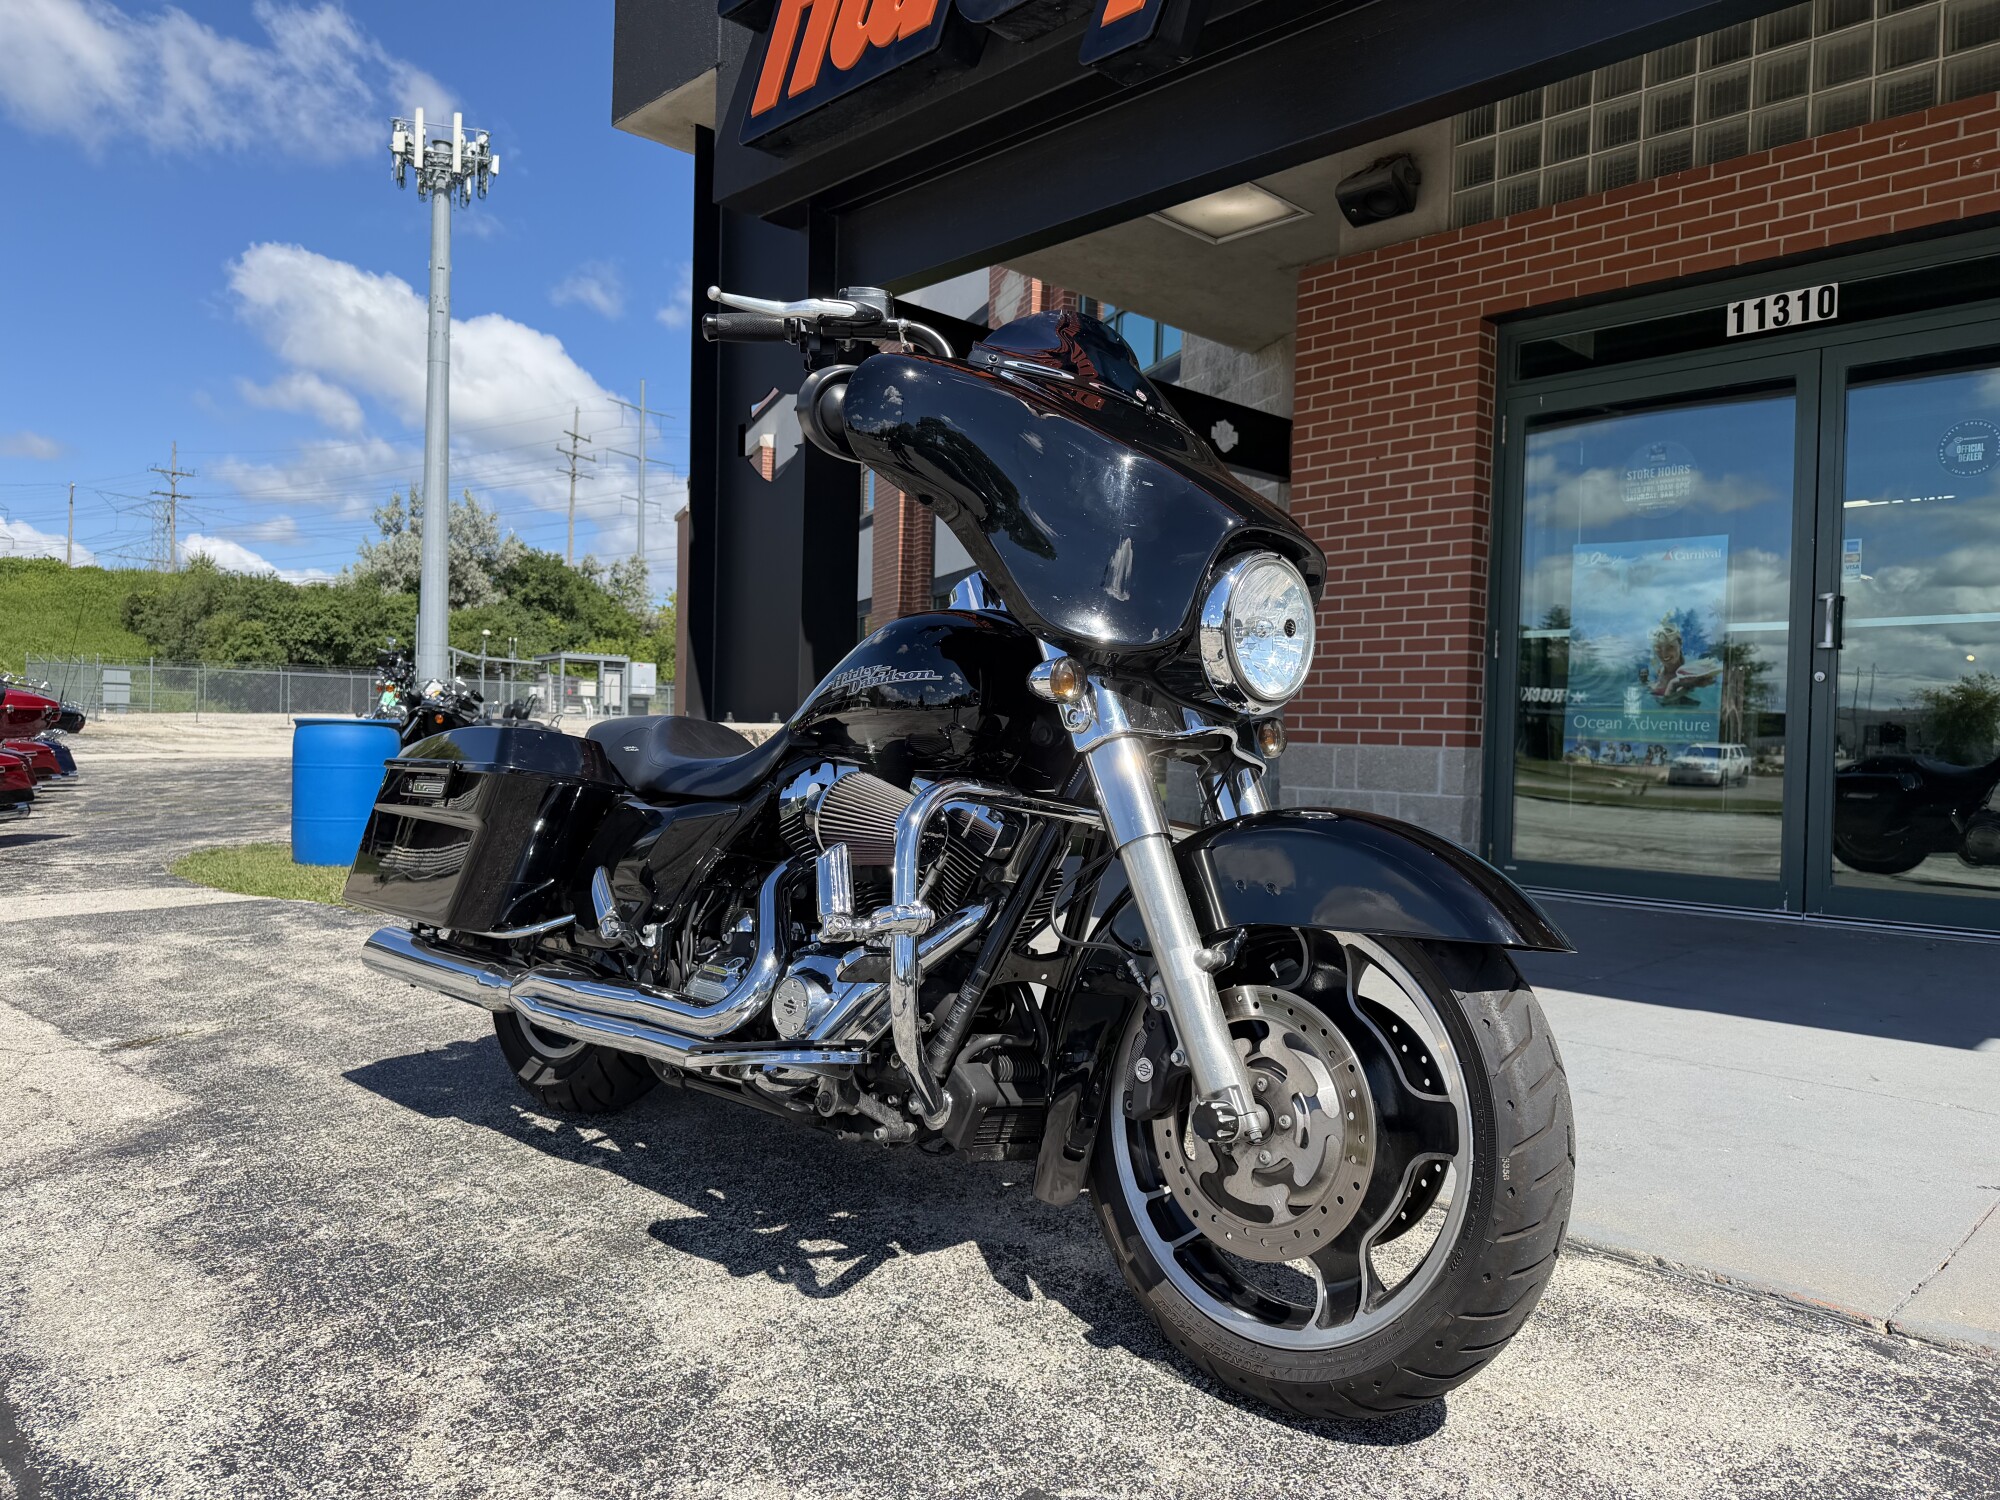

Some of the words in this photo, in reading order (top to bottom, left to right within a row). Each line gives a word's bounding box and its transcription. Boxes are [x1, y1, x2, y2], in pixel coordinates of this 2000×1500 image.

[1732, 285, 1836, 334] 11310
[1956, 443, 1985, 453] OFFICIAL
[1958, 452, 1983, 462] DEALER
[1626, 467, 1656, 481] STORE
[1657, 464, 1691, 477] HOURS
[1674, 548, 1722, 561] Carnival
[1573, 715, 1623, 730] Ocean
[1627, 715, 1711, 733] Adventure
